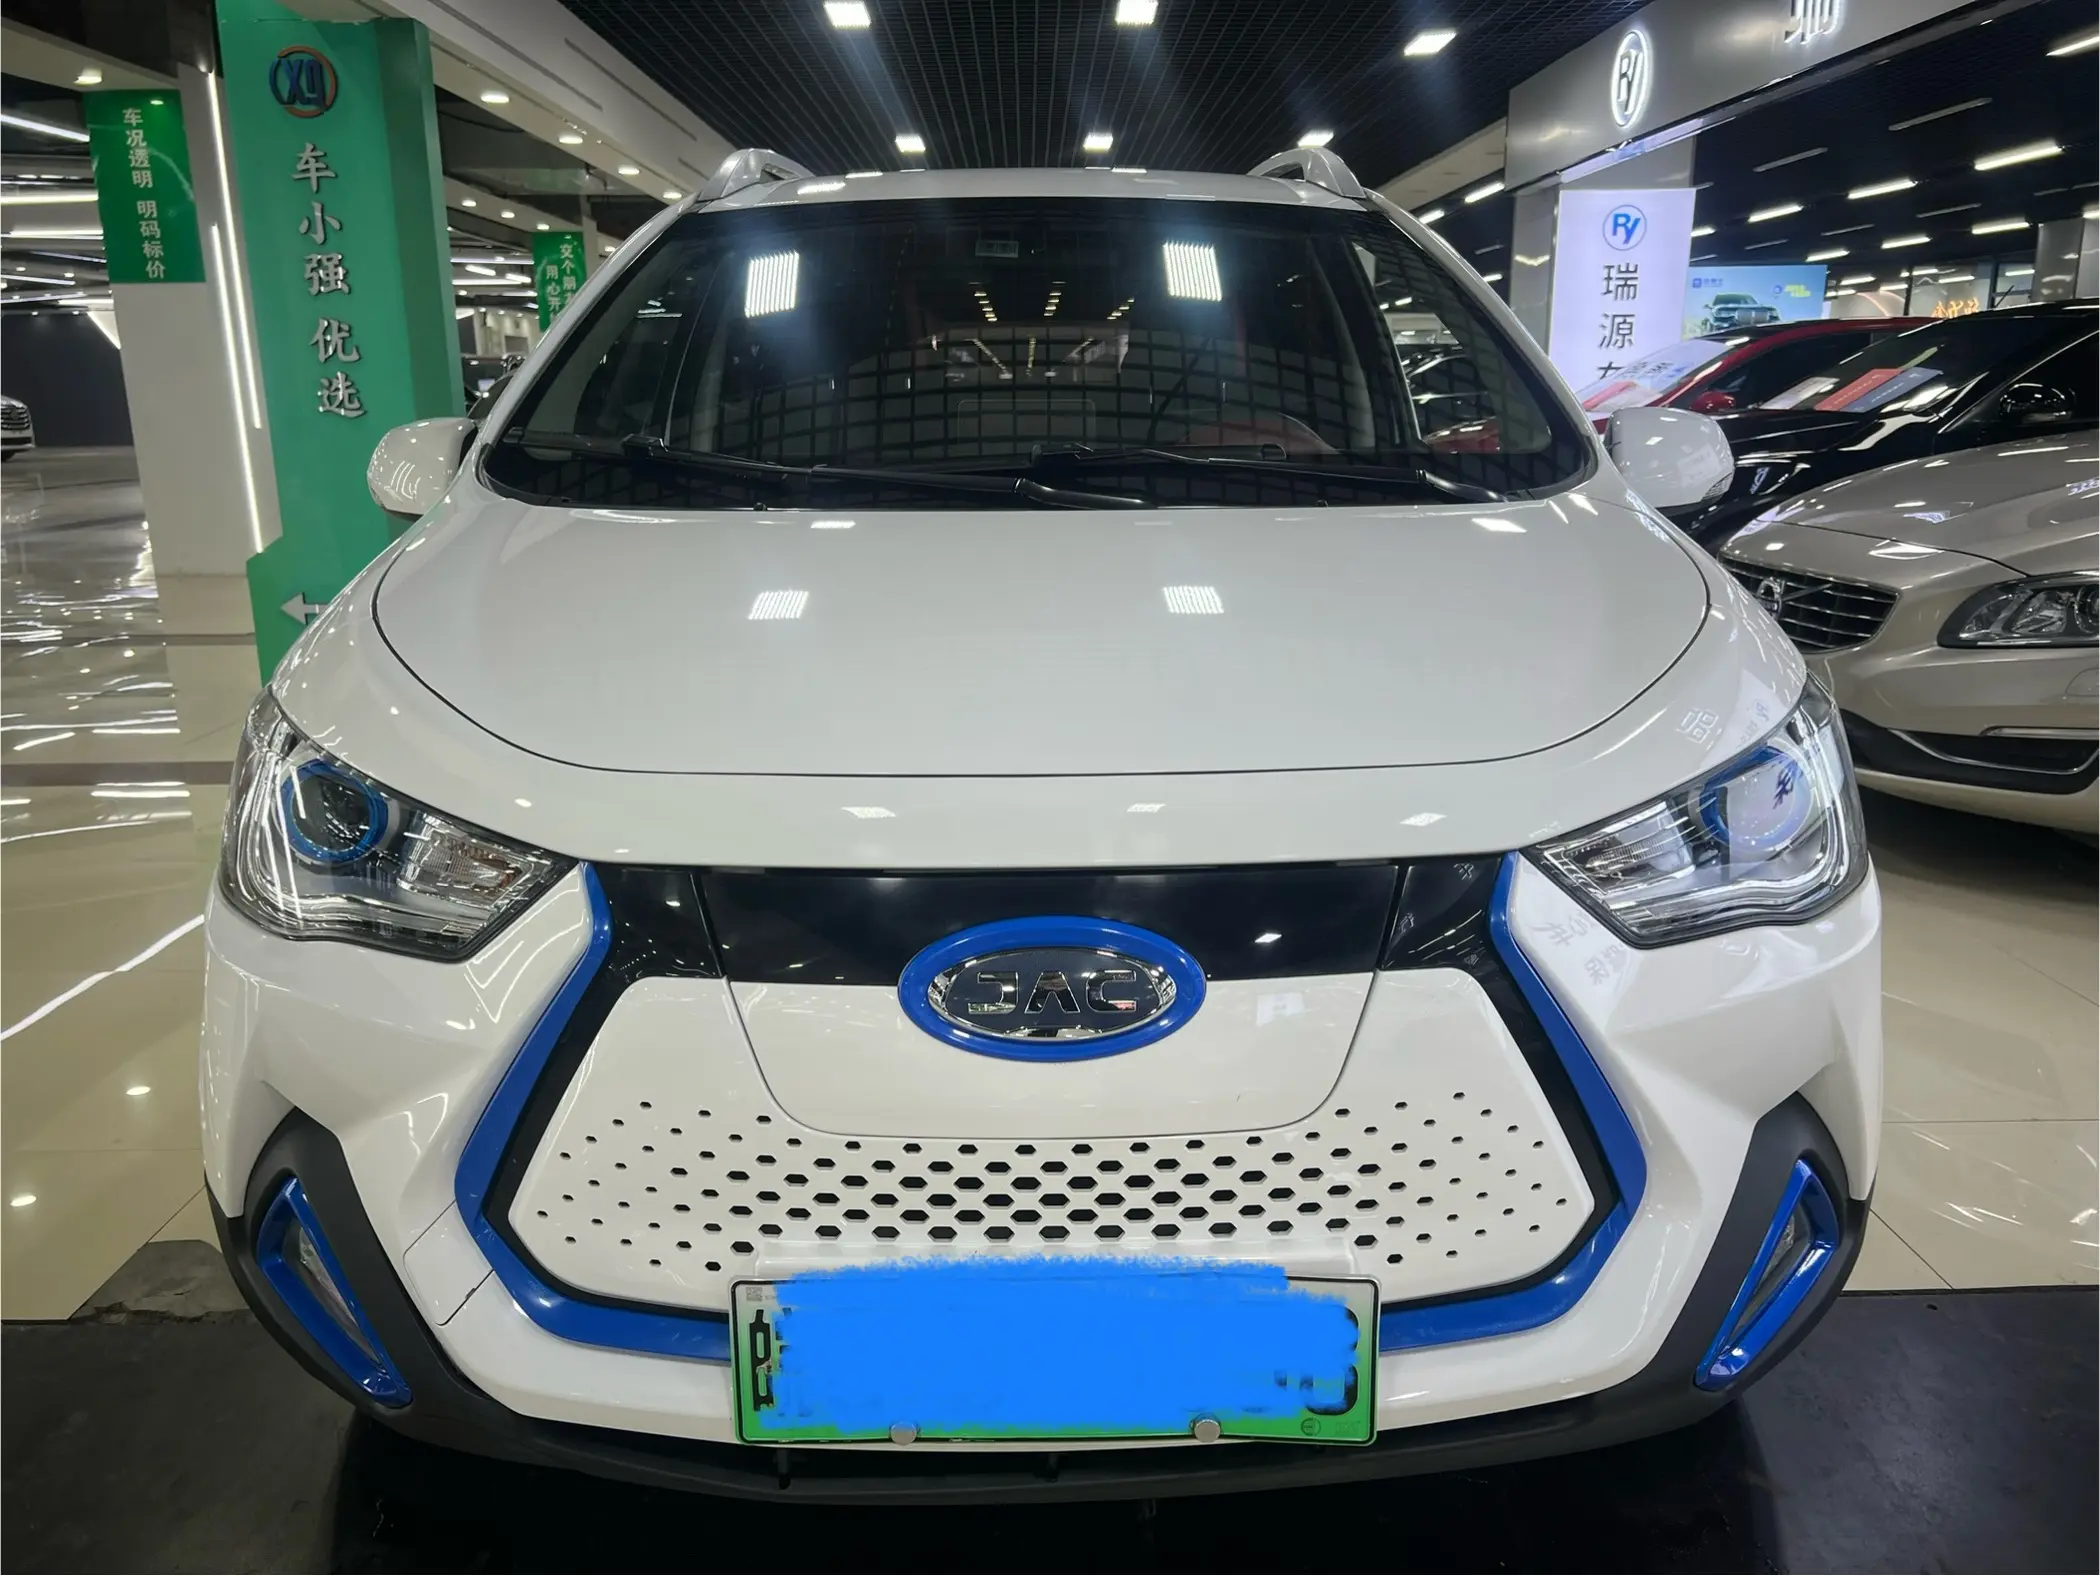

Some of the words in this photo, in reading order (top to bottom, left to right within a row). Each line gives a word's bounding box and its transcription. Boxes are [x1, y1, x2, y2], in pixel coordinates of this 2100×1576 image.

[122, 107, 153, 188] 车况透明
[137, 199, 165, 279] 明码标价
[292, 142, 352, 296] 车小强
[546, 264, 562, 319] 用心开
[309, 317, 366, 418] 优选
[967, 970, 1137, 1014] JAC
